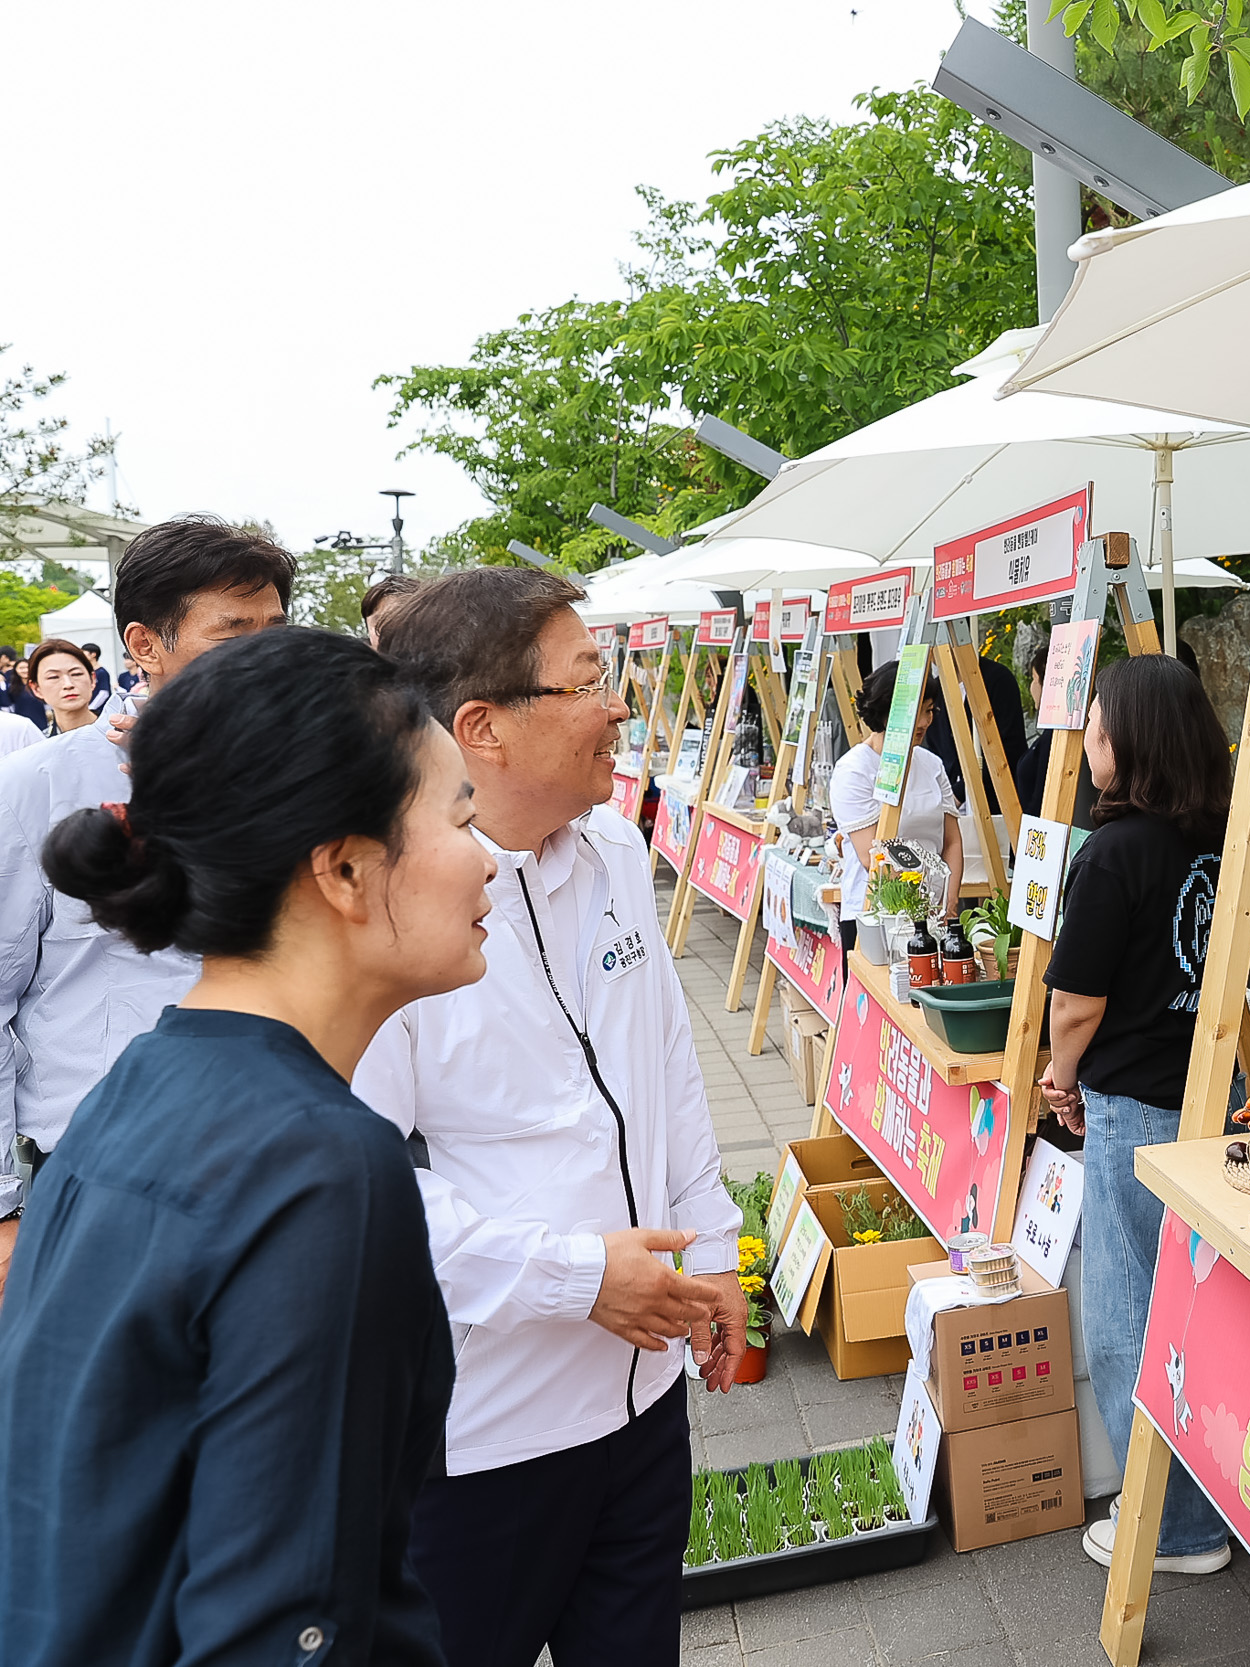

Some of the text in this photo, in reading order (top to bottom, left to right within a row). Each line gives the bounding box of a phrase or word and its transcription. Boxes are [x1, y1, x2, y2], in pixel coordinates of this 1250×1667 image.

[1025, 829, 1048, 861] 15%
[1026, 880, 1049, 920] 할인
[879, 1018, 933, 1116] 반려동물과
[871, 1074, 947, 1200] 함께하는 축제
